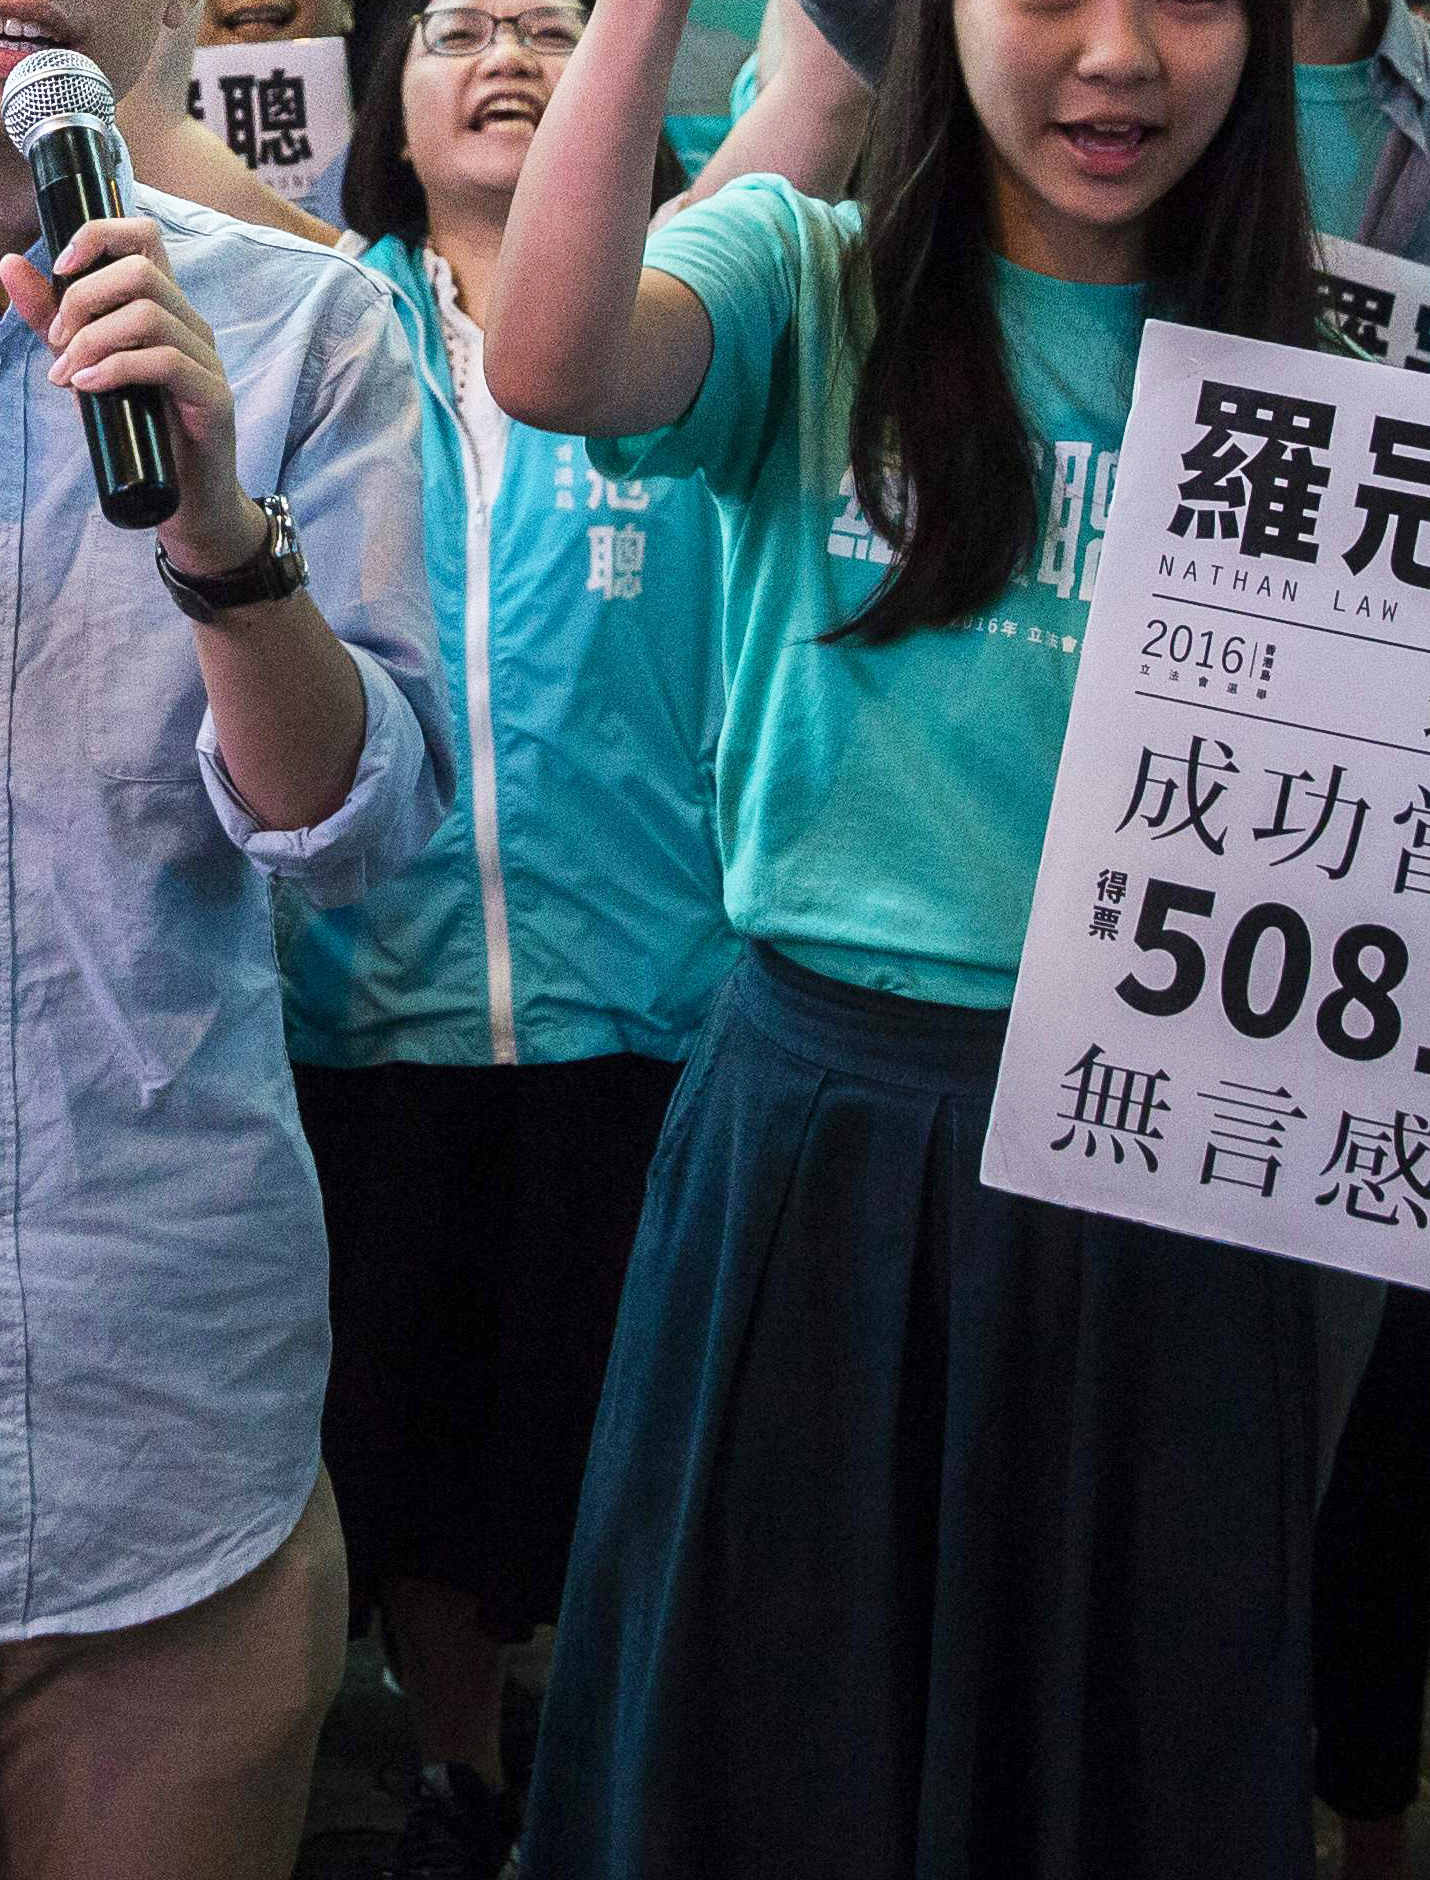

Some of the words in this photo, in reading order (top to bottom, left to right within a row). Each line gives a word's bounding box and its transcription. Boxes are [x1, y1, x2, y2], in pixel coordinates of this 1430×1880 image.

[187, 68, 313, 170] 聰
[1158, 553, 1299, 603] NATHAN
[1332, 593, 1398, 623] LAW
[1140, 619, 1245, 676] 2016
[1088, 868, 1129, 941] 得票
